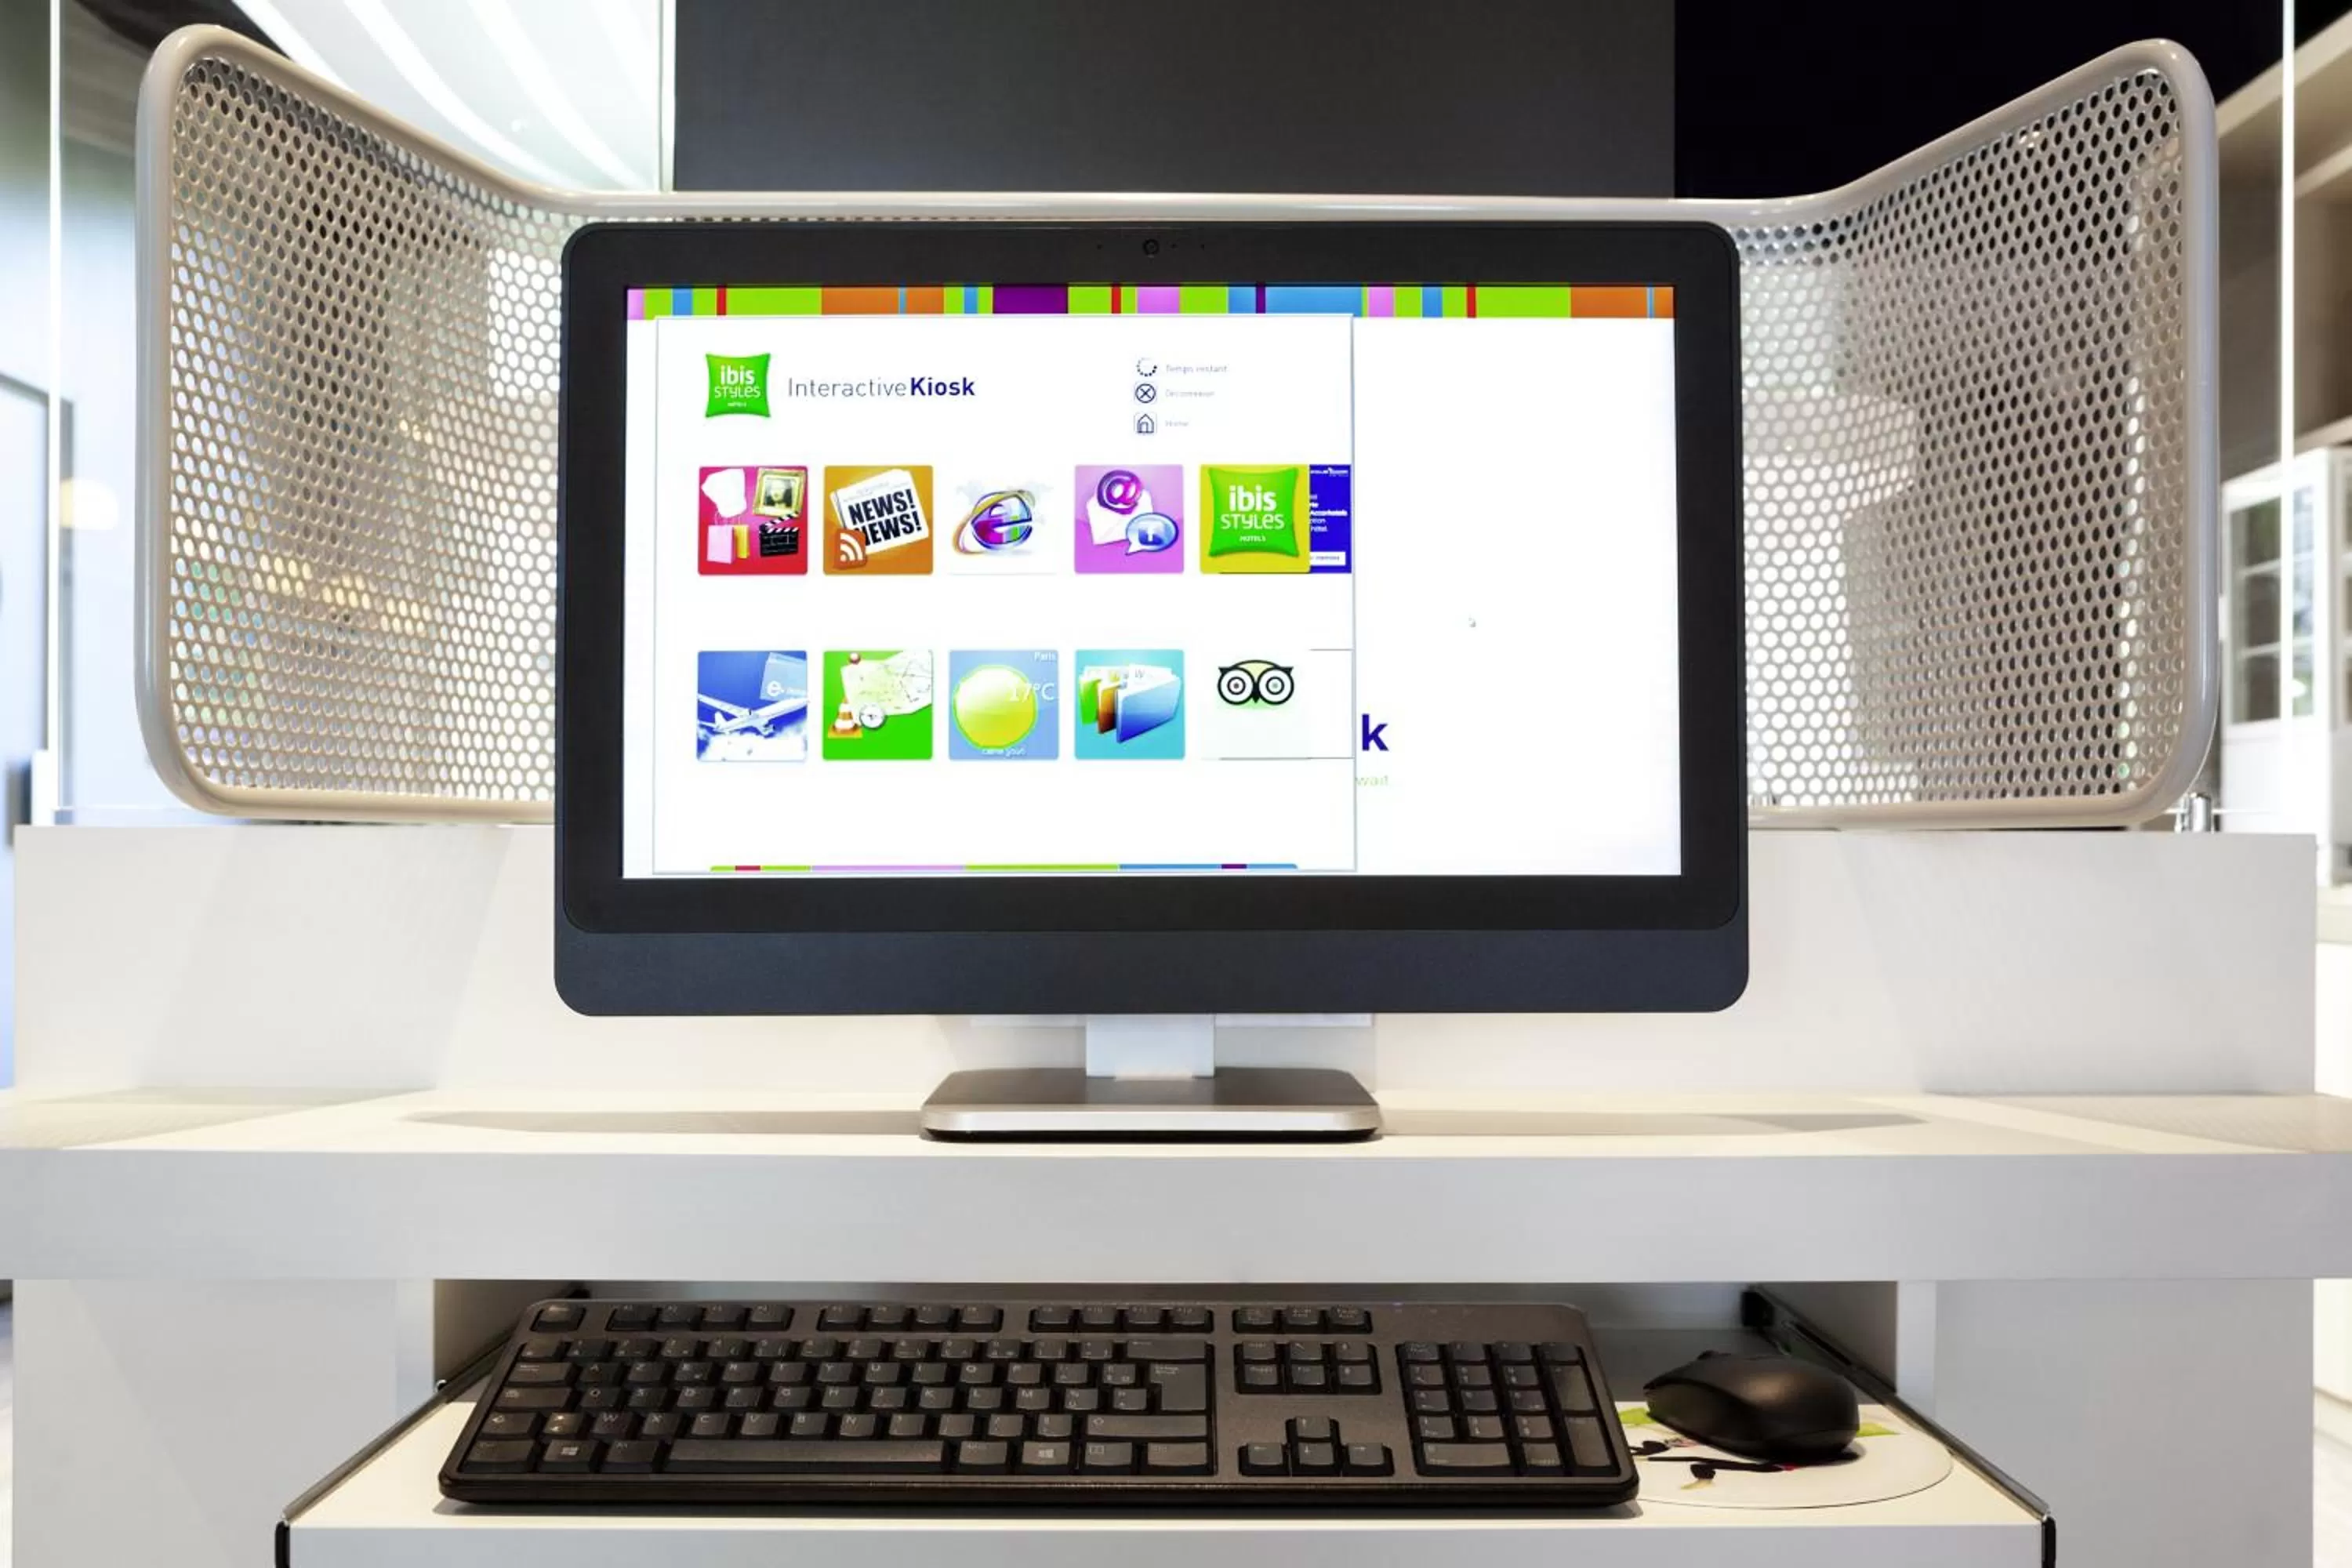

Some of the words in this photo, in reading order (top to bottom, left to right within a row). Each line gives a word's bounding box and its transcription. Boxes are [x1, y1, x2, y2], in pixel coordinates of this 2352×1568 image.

[720, 365, 756, 385] ibis
[848, 488, 916, 526] NEWS!
[1229, 485, 1278, 512] ibis
